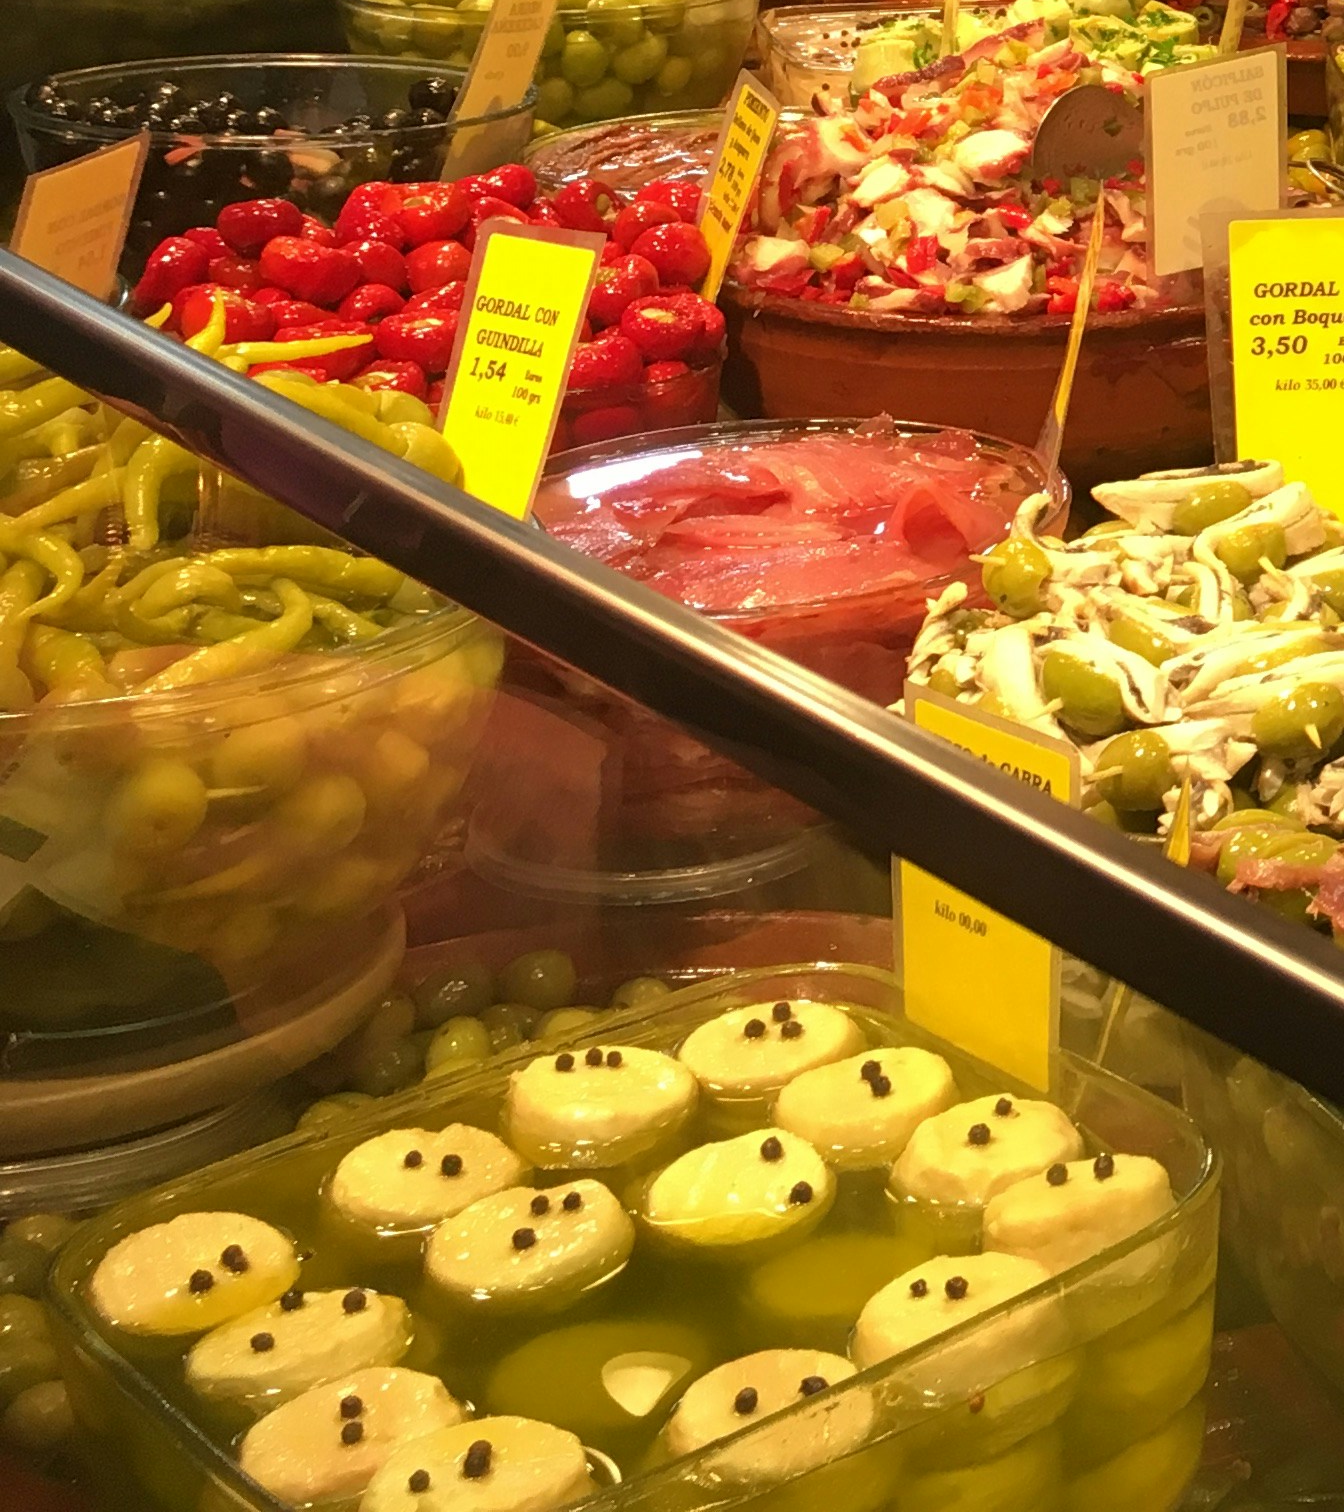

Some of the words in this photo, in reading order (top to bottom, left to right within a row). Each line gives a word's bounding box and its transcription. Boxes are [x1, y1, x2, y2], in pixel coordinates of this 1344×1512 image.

[1254, 281, 1340, 298] GORDAL
[475, 295, 531, 321] GORDAL
[535, 307, 560, 326] CON
[1250, 314, 1285, 326] con
[476, 328, 544, 358] GUINDILLA
[1251, 335, 1308, 359] 3,50
[469, 357, 507, 382] 1,54
[512, 386, 529, 399] 100
[528, 391, 541, 404] grs
[1275, 379, 1301, 391] kilo
[1305, 378, 1337, 391] 35,00
[475, 405, 492, 420] kilo
[934, 899, 956, 924] kilo
[958, 911, 988, 938] 00,00
